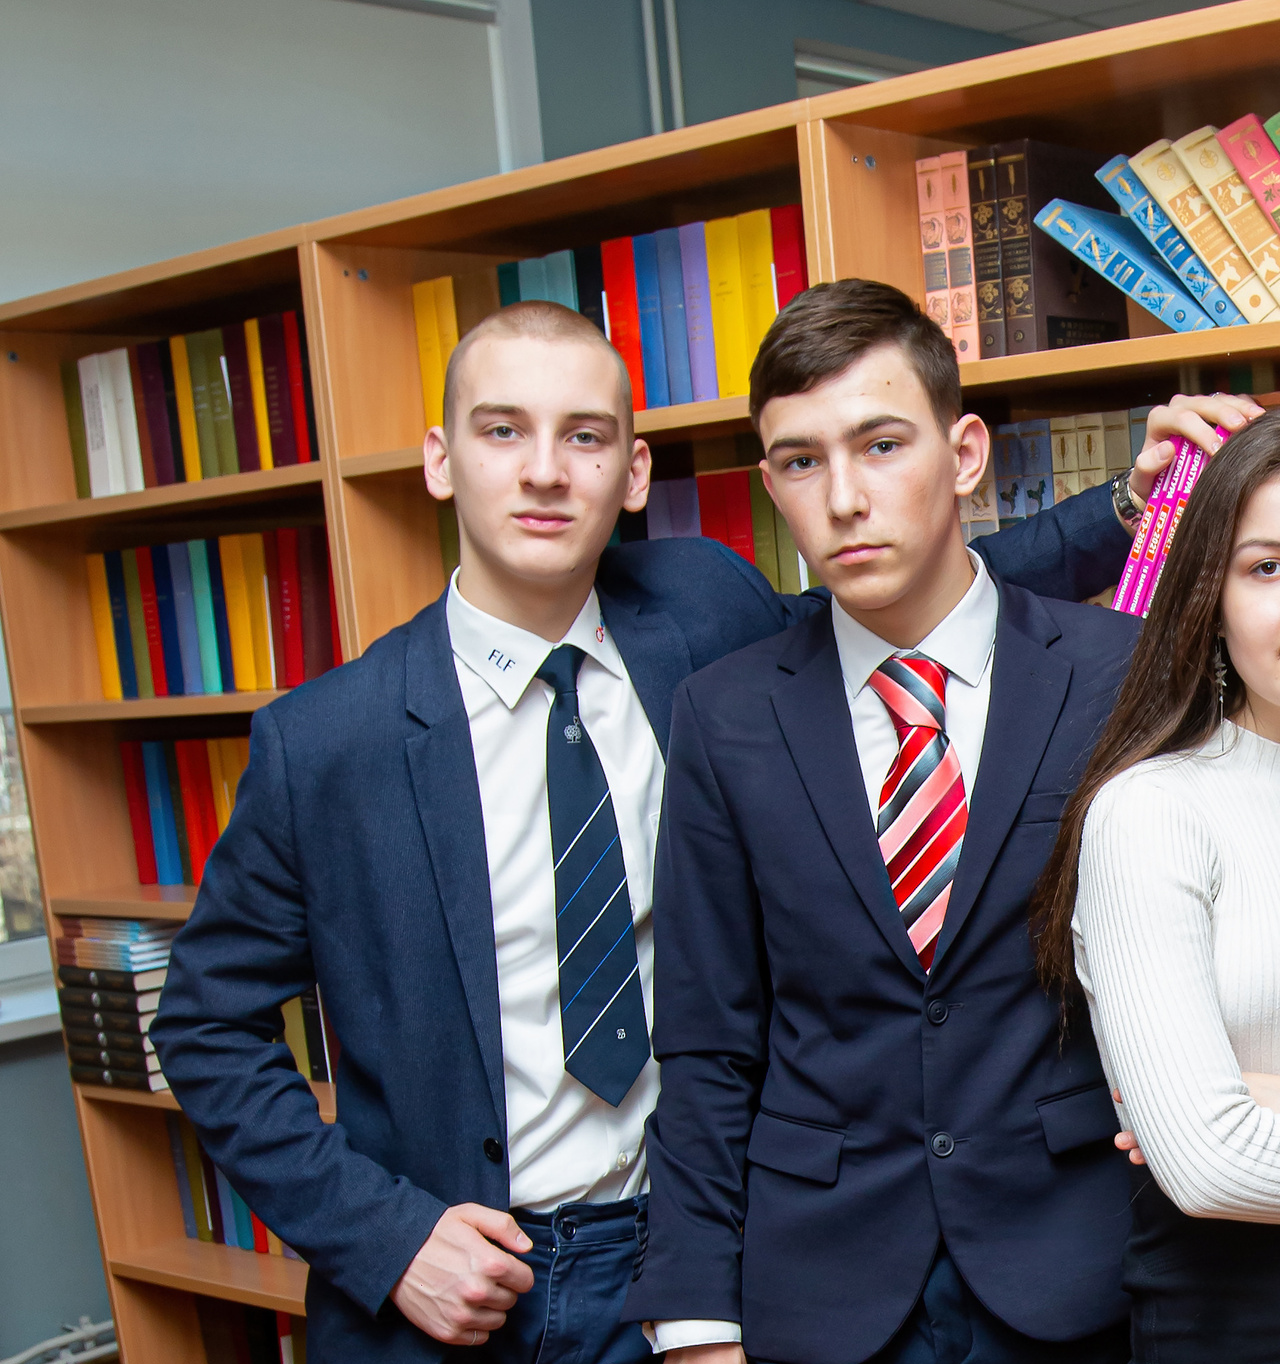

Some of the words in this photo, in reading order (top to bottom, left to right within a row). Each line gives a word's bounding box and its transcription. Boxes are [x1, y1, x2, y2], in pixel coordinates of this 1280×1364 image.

[1152, 468, 1166, 498] АТУРА
[1166, 441, 1190, 499] ЛИТЕРАТУРА
[1183, 447, 1202, 494] ТЕРАТУРА
[1133, 510, 1152, 554] ЕГЭ-2021
[1149, 510, 1168, 554] ЕГЭ-2021
[1128, 564, 1134, 572] 15
[1114, 572, 1133, 612] ВАРИАНТОВ
[1130, 573, 1148, 613] ВАРИАНТОВ
[488, 648, 516, 672] FLF
